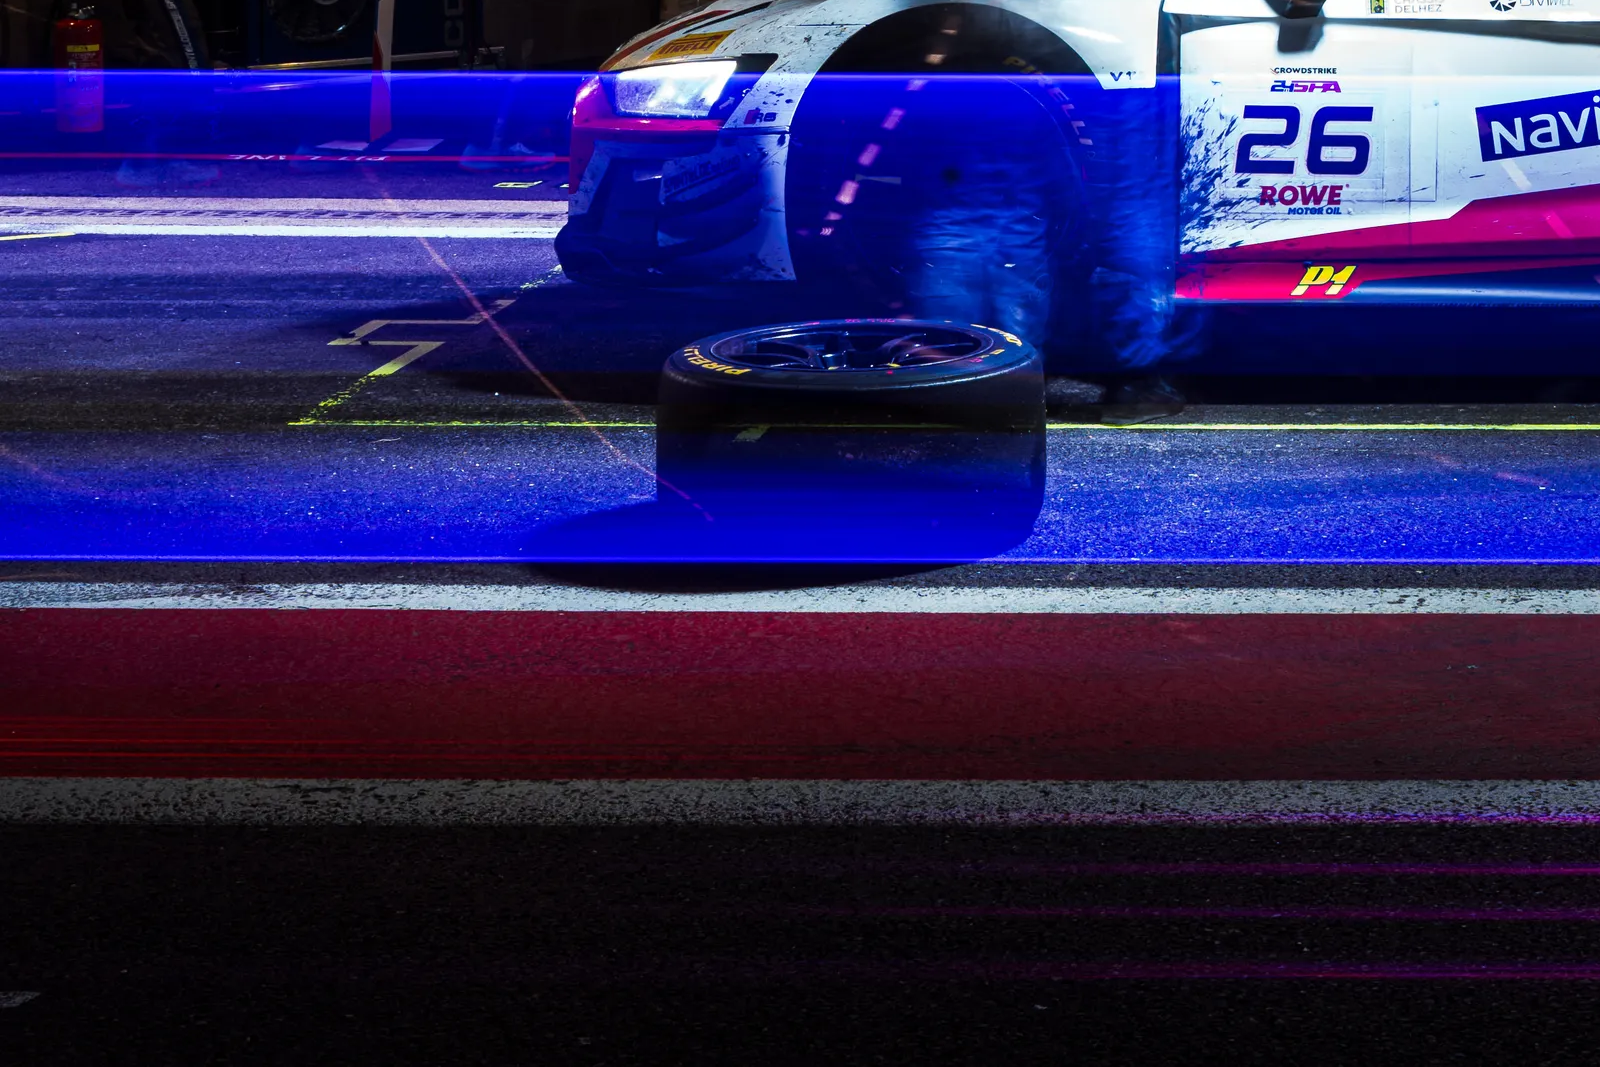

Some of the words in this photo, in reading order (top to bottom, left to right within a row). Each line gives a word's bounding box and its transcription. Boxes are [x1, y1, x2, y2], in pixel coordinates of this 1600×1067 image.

[1394, 4, 1443, 14] DELHEZ
[659, 33, 724, 55] PIRELLI
[1270, 67, 1337, 75] CROWDSTRIKE
[1235, 105, 1374, 175] 26
[1259, 185, 1344, 206] ROWE
[1287, 207, 1324, 215] MOTOR
[1325, 207, 1342, 215] OIL
